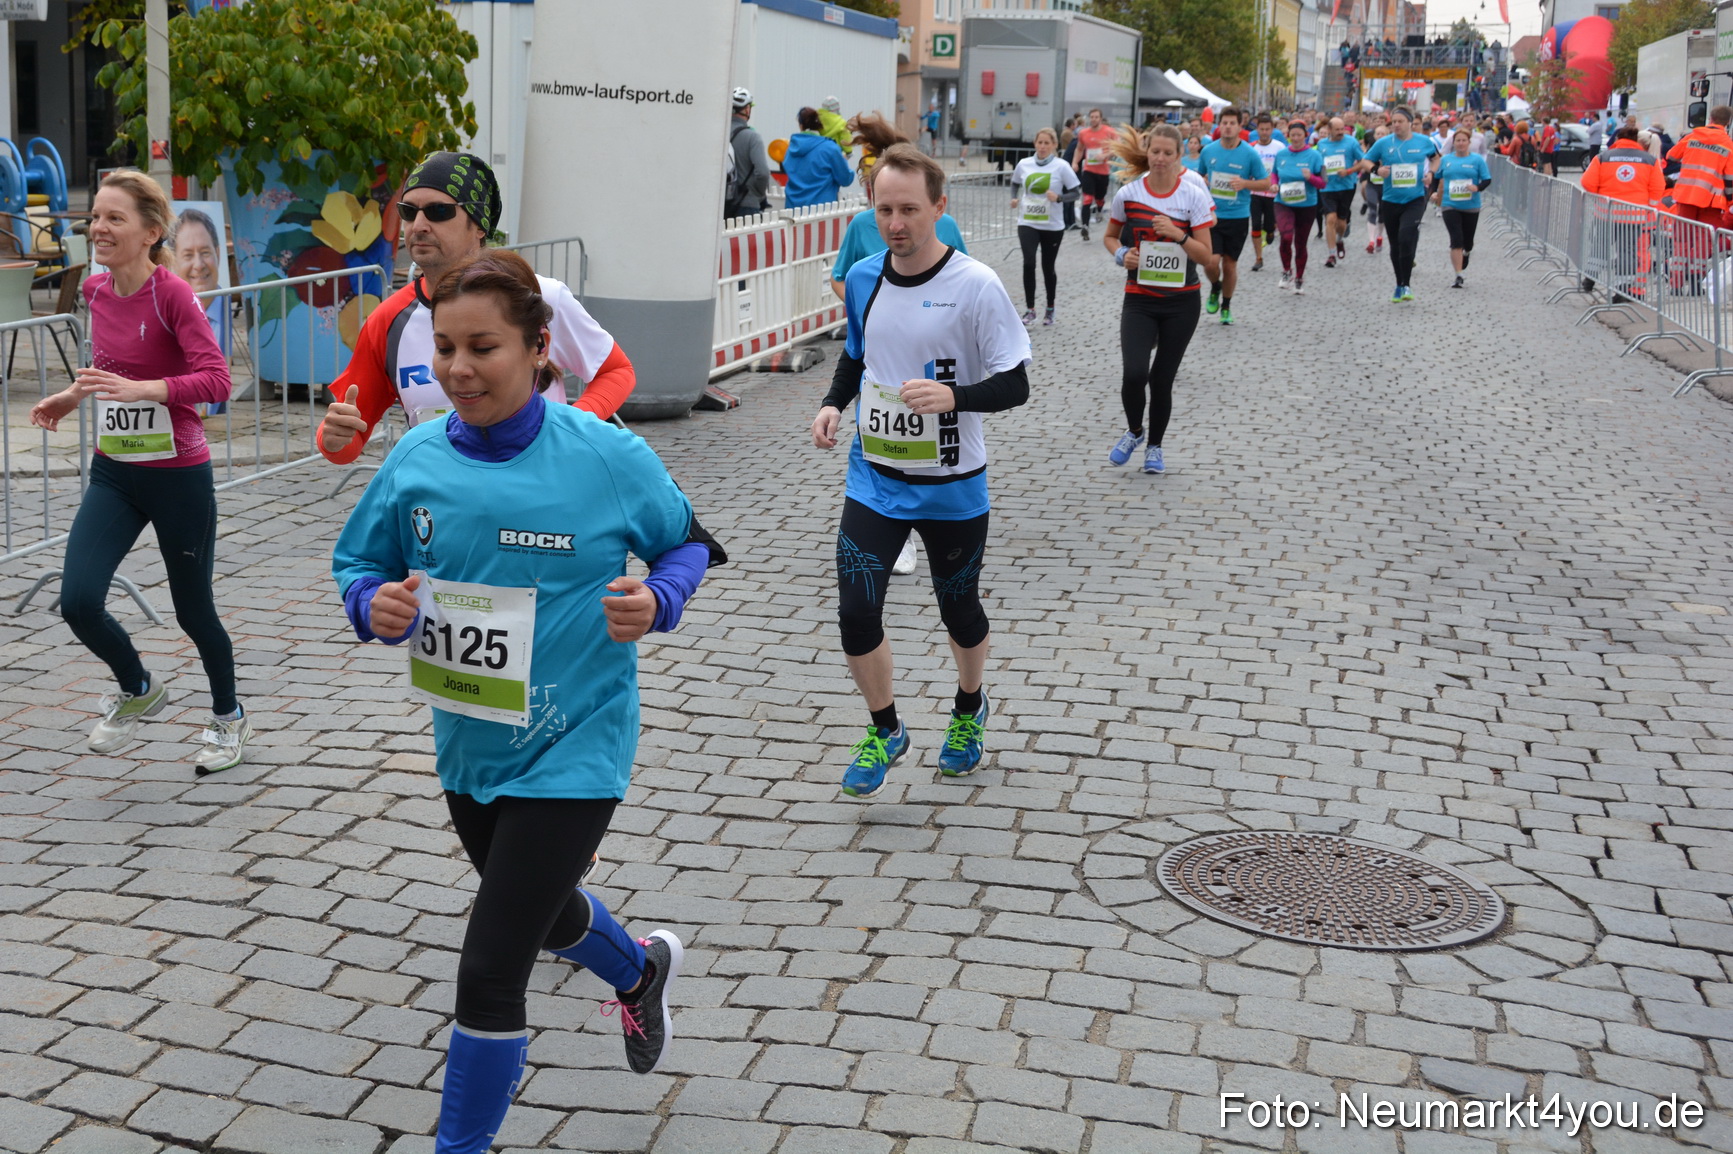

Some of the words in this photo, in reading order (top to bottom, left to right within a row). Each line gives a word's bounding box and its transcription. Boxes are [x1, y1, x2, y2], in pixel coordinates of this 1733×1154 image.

[936, 37, 953, 54] D
[531, 80, 694, 104] www.bmw-laufsport.de
[1689, 140, 1727, 155] NOTARZT
[1146, 255, 1180, 270] 5020
[106, 407, 155, 431] 5077
[869, 408, 924, 437] 5149
[935, 358, 960, 467] HBER
[121, 439, 145, 448] Maria
[883, 443, 908, 455] Stefan
[500, 529, 575, 550] BOCK
[444, 593, 492, 608] BOCK
[421, 616, 508, 670] 5125
[443, 675, 480, 695] Joana
